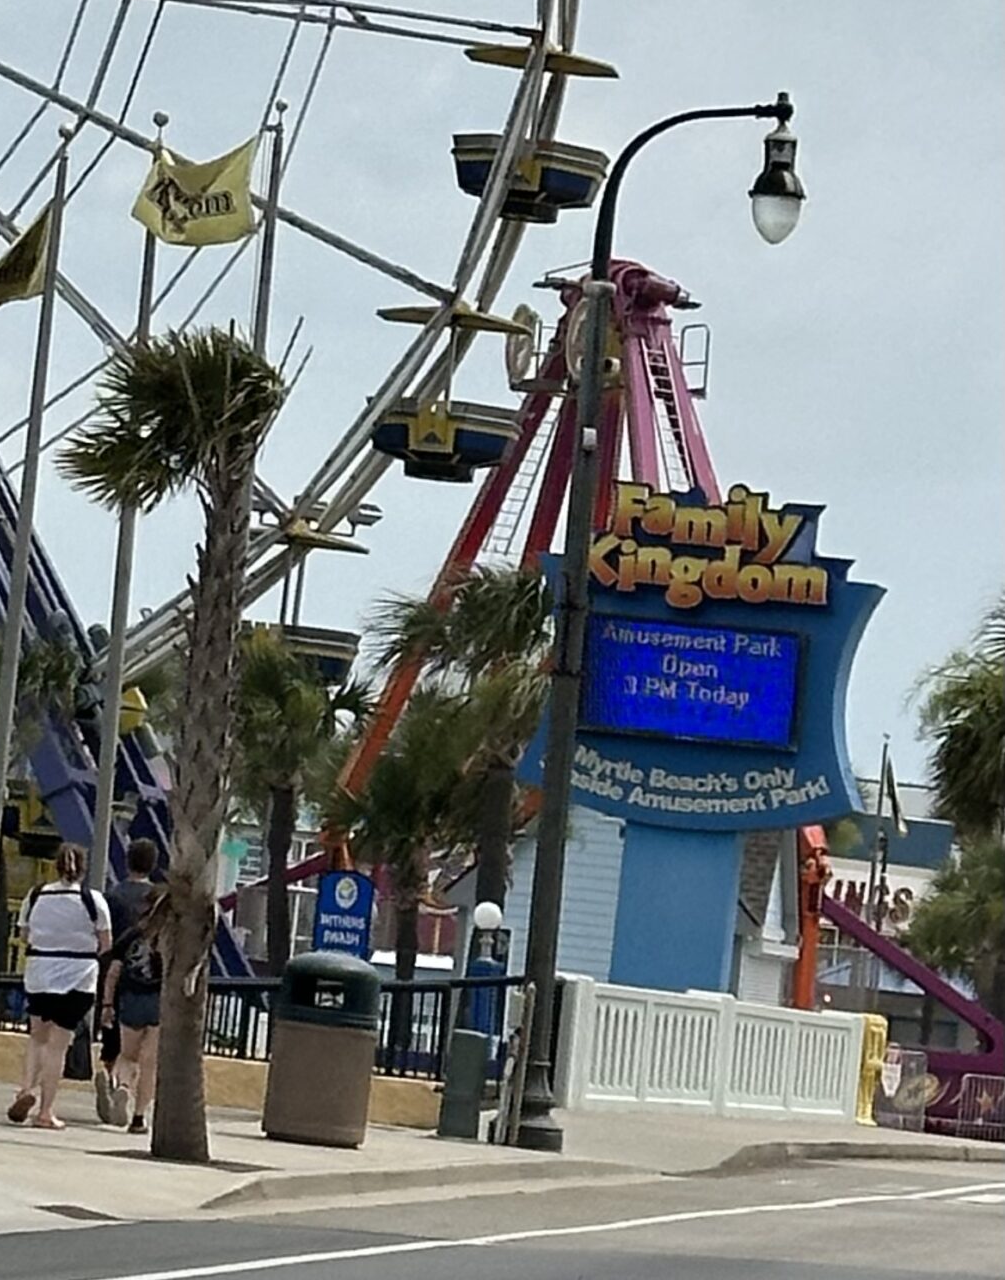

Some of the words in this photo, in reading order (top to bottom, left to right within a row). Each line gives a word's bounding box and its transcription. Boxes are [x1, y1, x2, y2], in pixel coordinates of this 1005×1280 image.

[614, 483, 803, 563] Family
[588, 533, 828, 608] Kingdom
[603, 623, 726, 652] Amusement
[734, 633, 782, 657] Park
[662, 653, 719, 678] Open
[645, 676, 678, 699] PM
[686, 681, 750, 709] Today
[574, 744, 644, 783] Myrtle
[649, 768, 739, 793] Beach's
[744, 767, 795, 789] Only
[627, 786, 767, 814] Amusement
